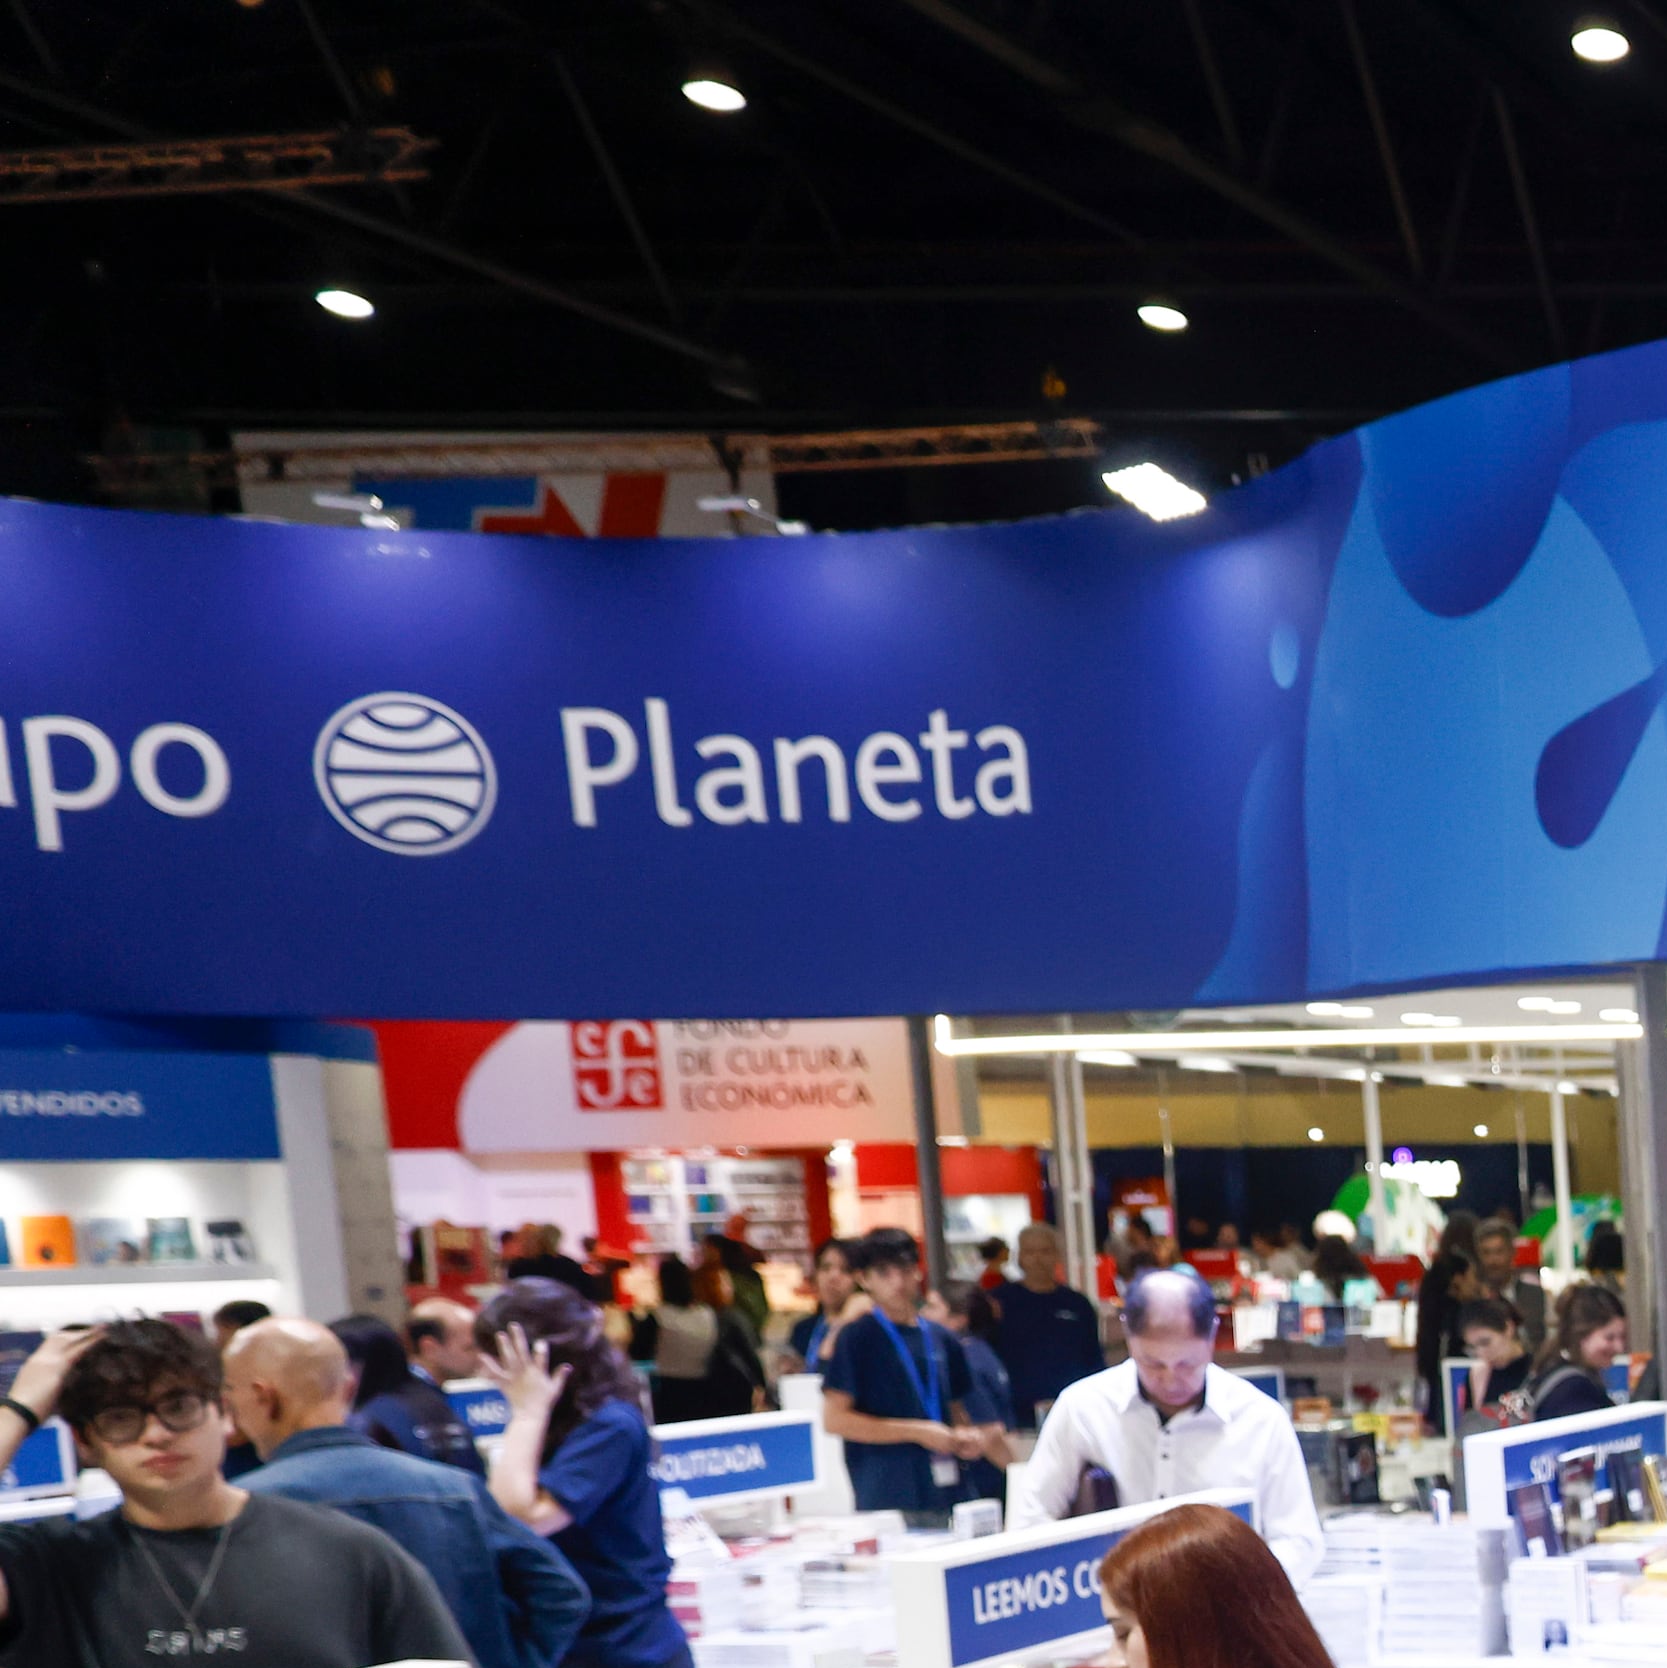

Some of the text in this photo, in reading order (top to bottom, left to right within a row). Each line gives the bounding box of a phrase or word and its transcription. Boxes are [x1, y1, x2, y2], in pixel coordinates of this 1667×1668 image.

[0, 697, 1032, 852] po Planeta
[676, 1046, 869, 1076] DE CULTURA
[973, 1567, 1068, 1625] LEEMOS
